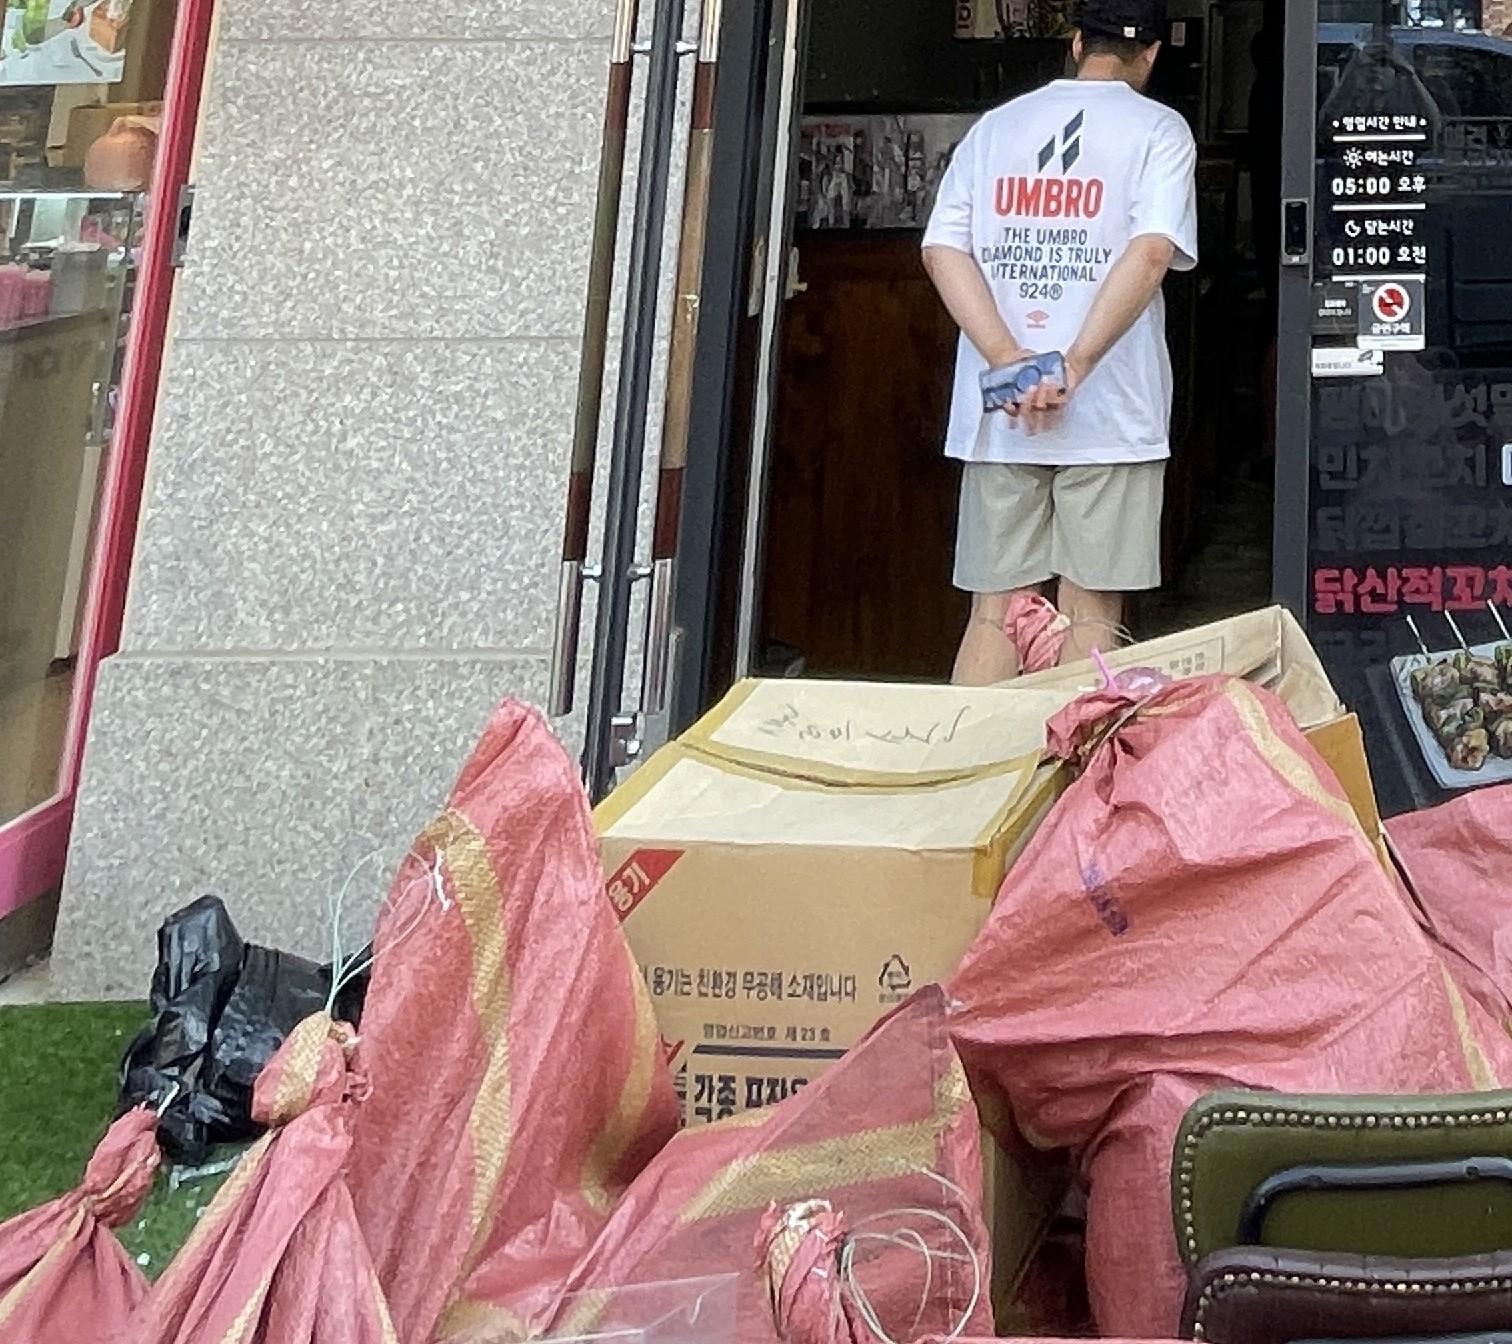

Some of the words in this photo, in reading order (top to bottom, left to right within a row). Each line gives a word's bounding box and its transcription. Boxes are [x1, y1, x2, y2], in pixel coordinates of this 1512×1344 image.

[1342, 115, 1389, 131] 영업시간
[1392, 115, 1416, 130] 안내
[1364, 150, 1414, 165] 여는시간
[1332, 177, 1391, 195] 05:00
[1397, 176, 1426, 193] 오후
[995, 176, 1104, 220] UMBRO
[1003, 227, 1031, 244] THE
[1036, 228, 1088, 246] UMBRO
[981, 245, 1043, 264] DAMOND
[1049, 247, 1063, 263] IS
[1068, 247, 1112, 264] TRULY
[1332, 247, 1391, 265] 01:00
[1396, 246, 1426, 264] 오전
[608, 861, 650, 912] 용기
[653, 966, 692, 997] 용기는
[697, 967, 737, 1000] 친환경
[786, 972, 857, 1004] 소재입니다
